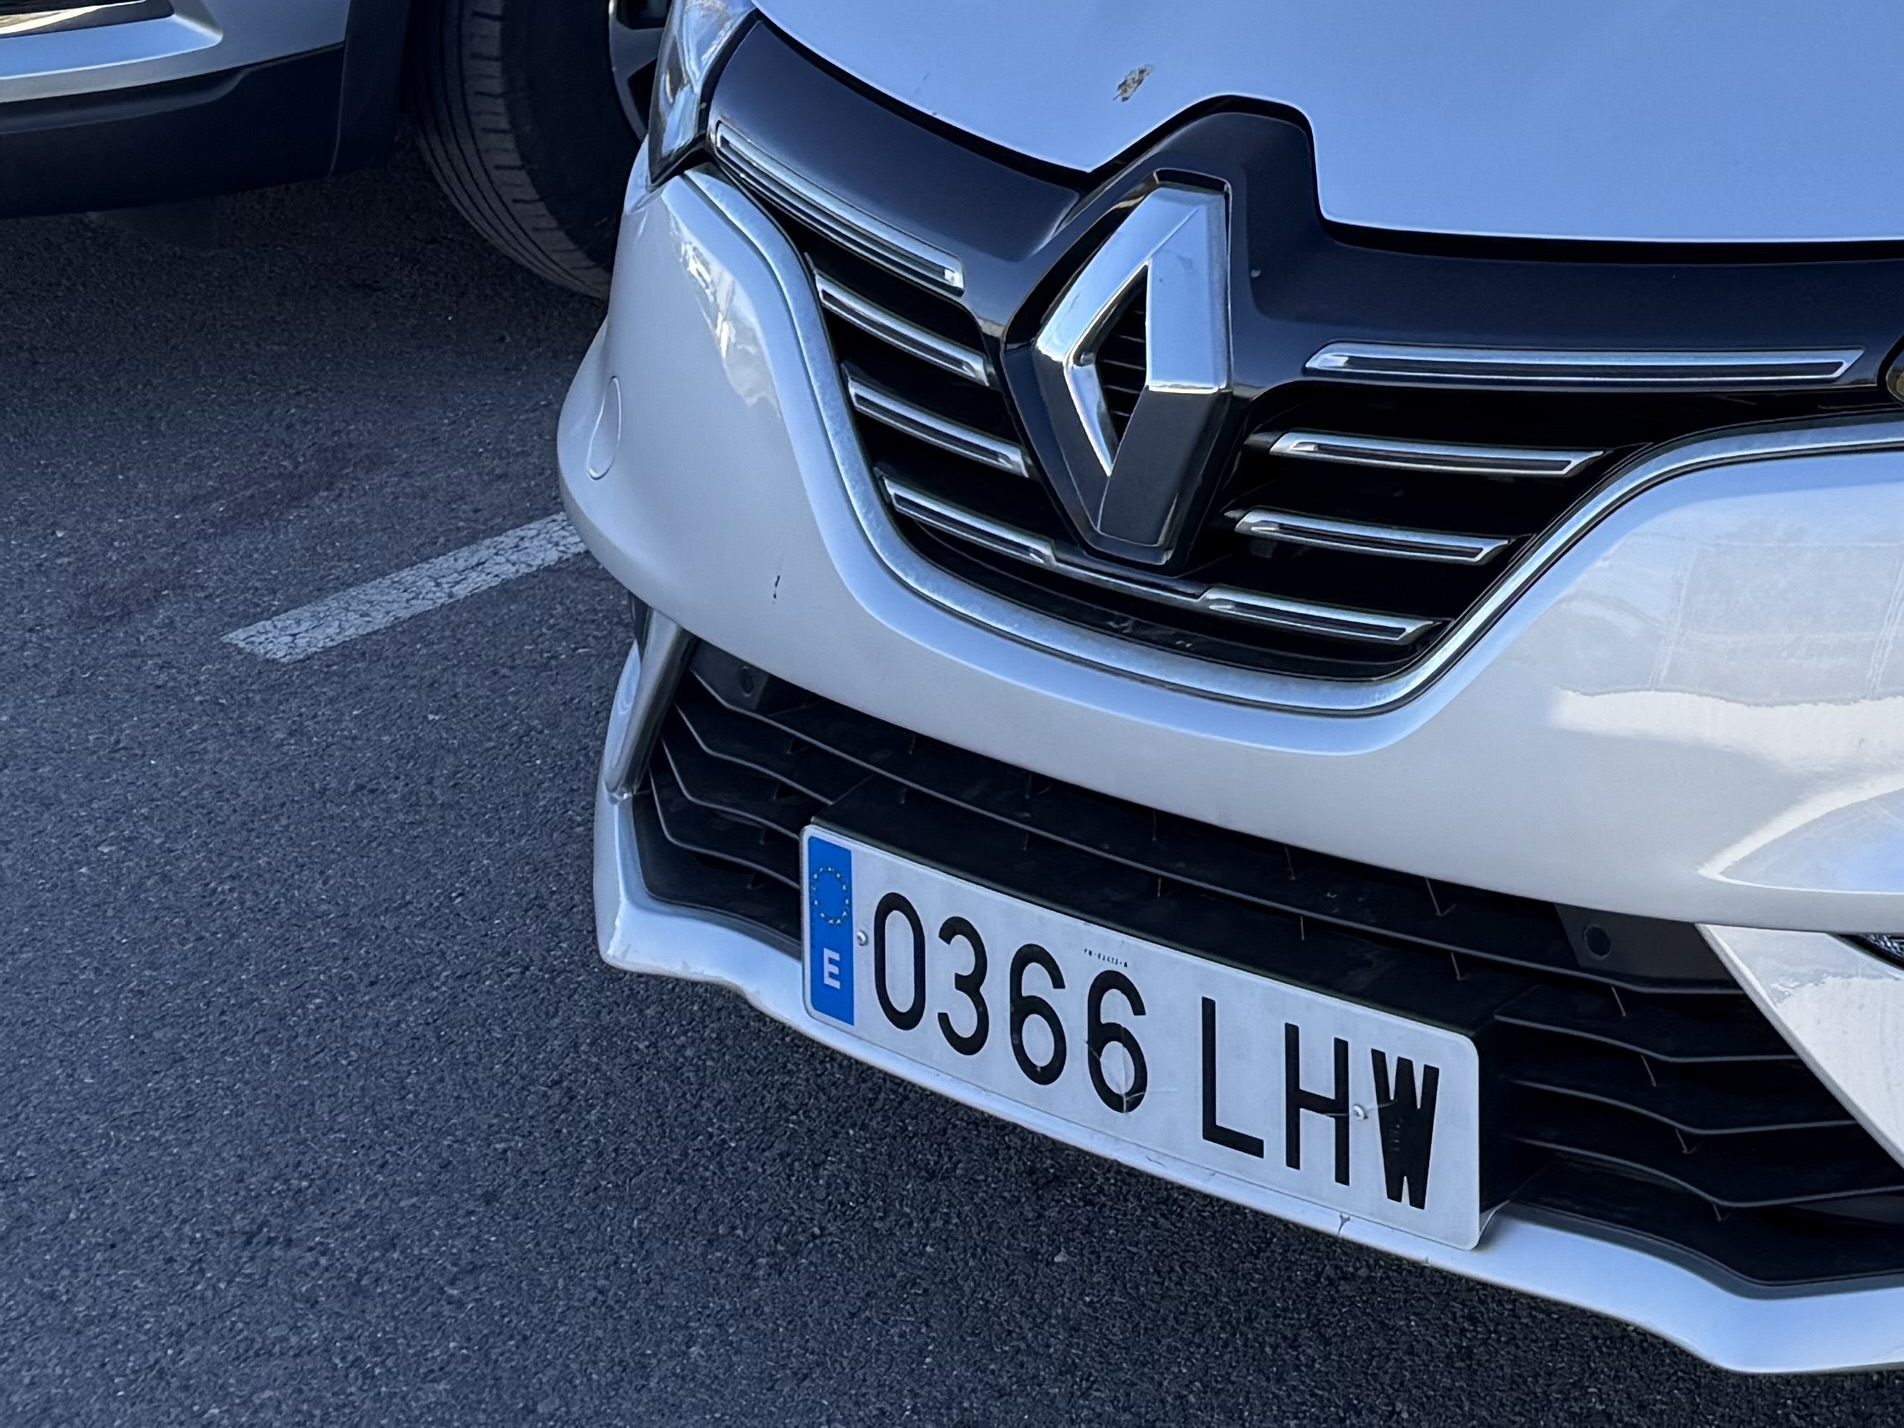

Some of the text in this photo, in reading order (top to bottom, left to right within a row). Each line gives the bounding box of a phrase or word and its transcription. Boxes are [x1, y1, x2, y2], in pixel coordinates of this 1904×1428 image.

[824, 947, 842, 990] E
[873, 892, 1440, 1210] 0366 LHW
